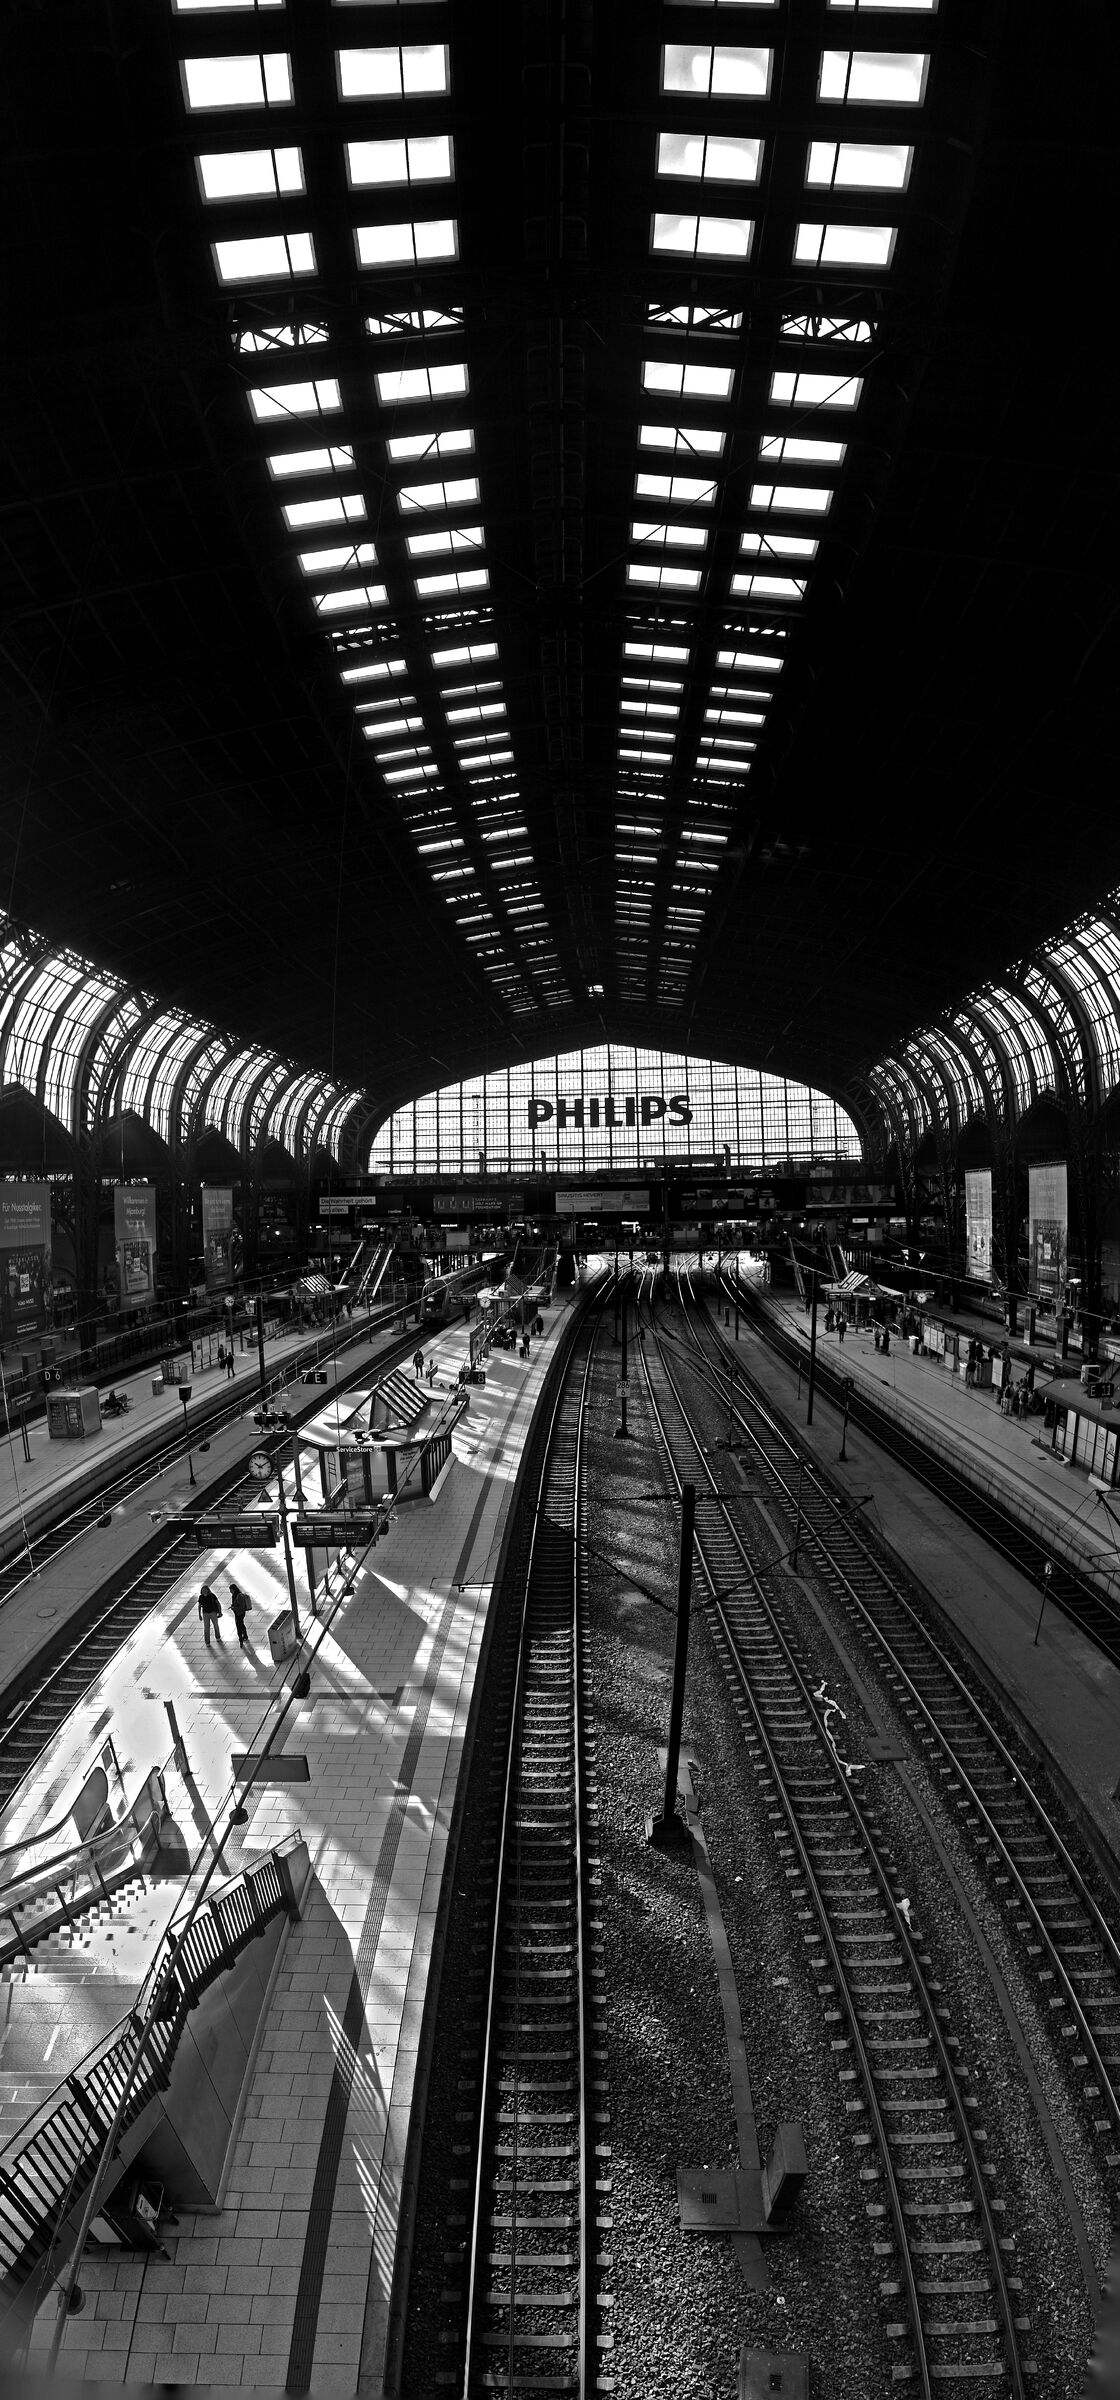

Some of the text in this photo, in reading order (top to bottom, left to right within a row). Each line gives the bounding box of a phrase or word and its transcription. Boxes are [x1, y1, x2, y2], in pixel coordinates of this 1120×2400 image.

[528, 1095, 693, 1129] PHILIPS
[45, 1371, 61, 1381] D 6
[315, 1373, 321, 1383] E
[1090, 1384, 1111, 1397] E 11
